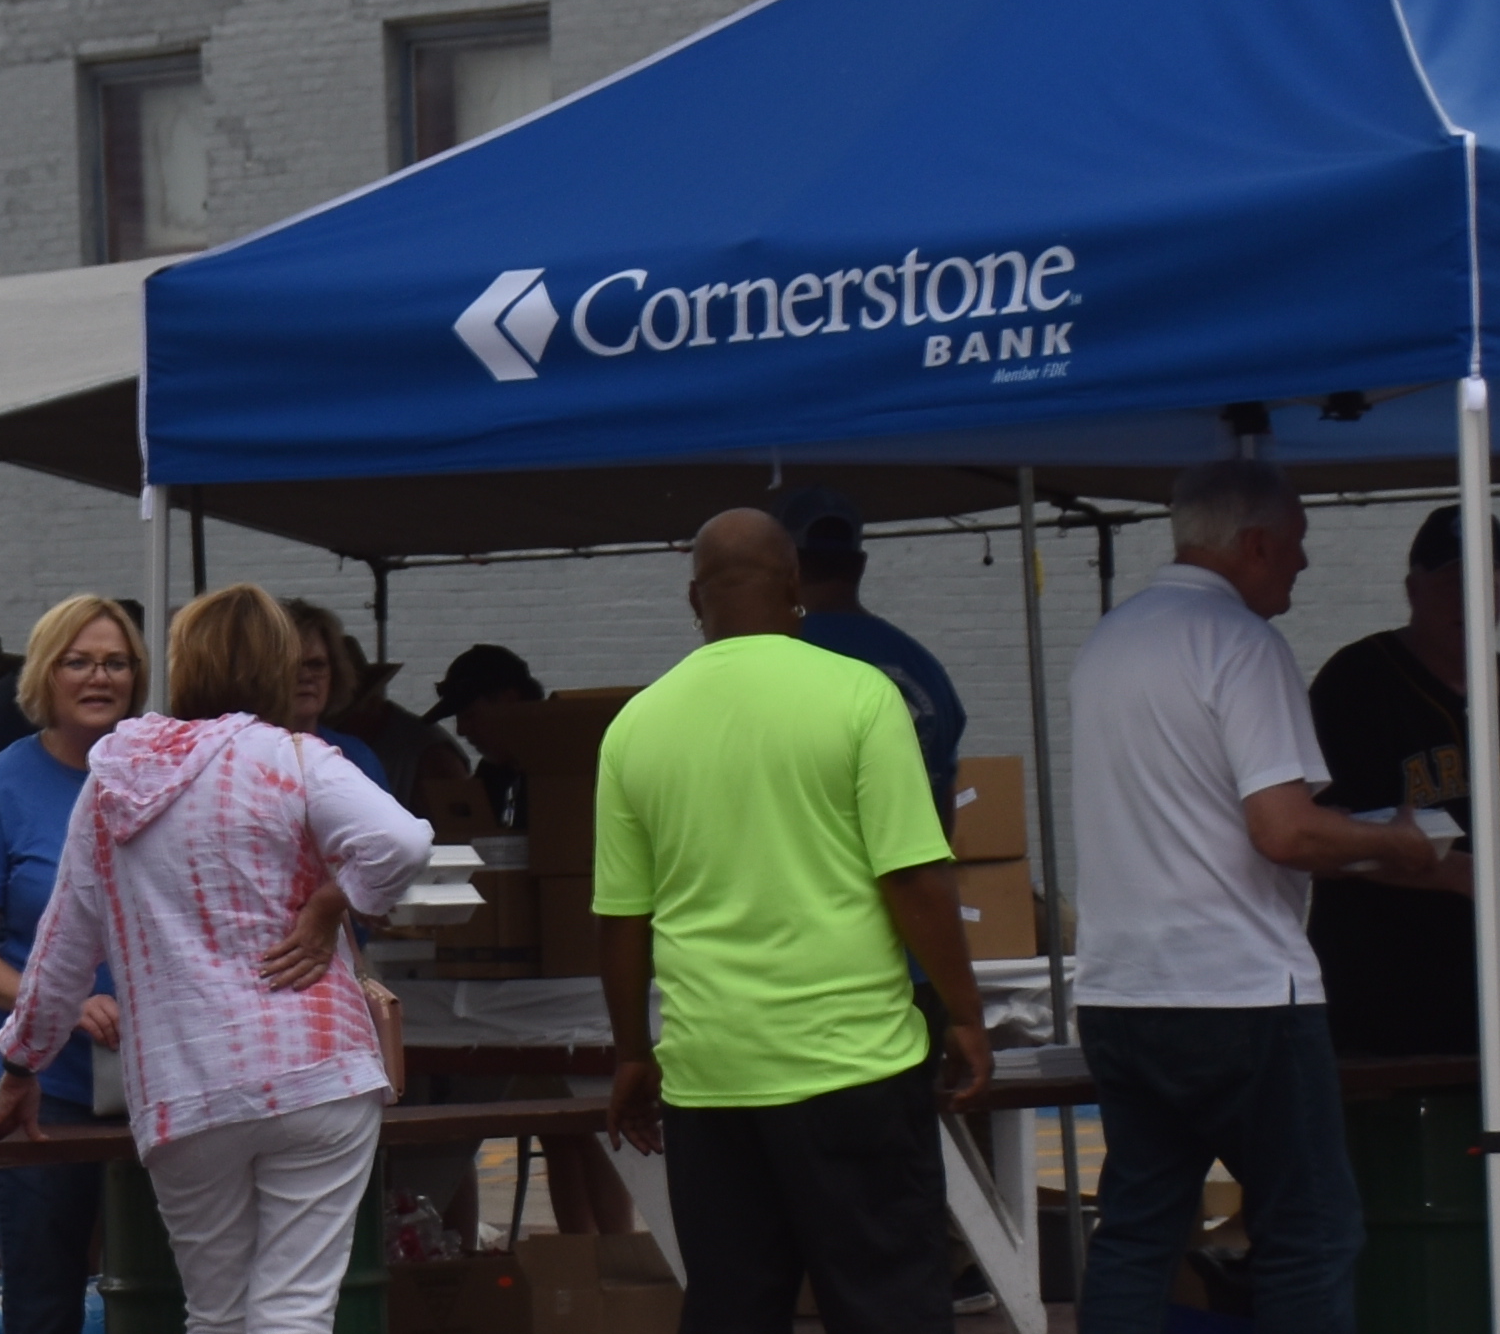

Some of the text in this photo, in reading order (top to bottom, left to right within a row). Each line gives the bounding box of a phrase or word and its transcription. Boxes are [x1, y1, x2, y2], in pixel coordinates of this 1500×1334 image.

[571, 245, 1075, 356] Cornerstone
[924, 322, 1073, 367] BANK
[992, 361, 1070, 383] Member FDIC
